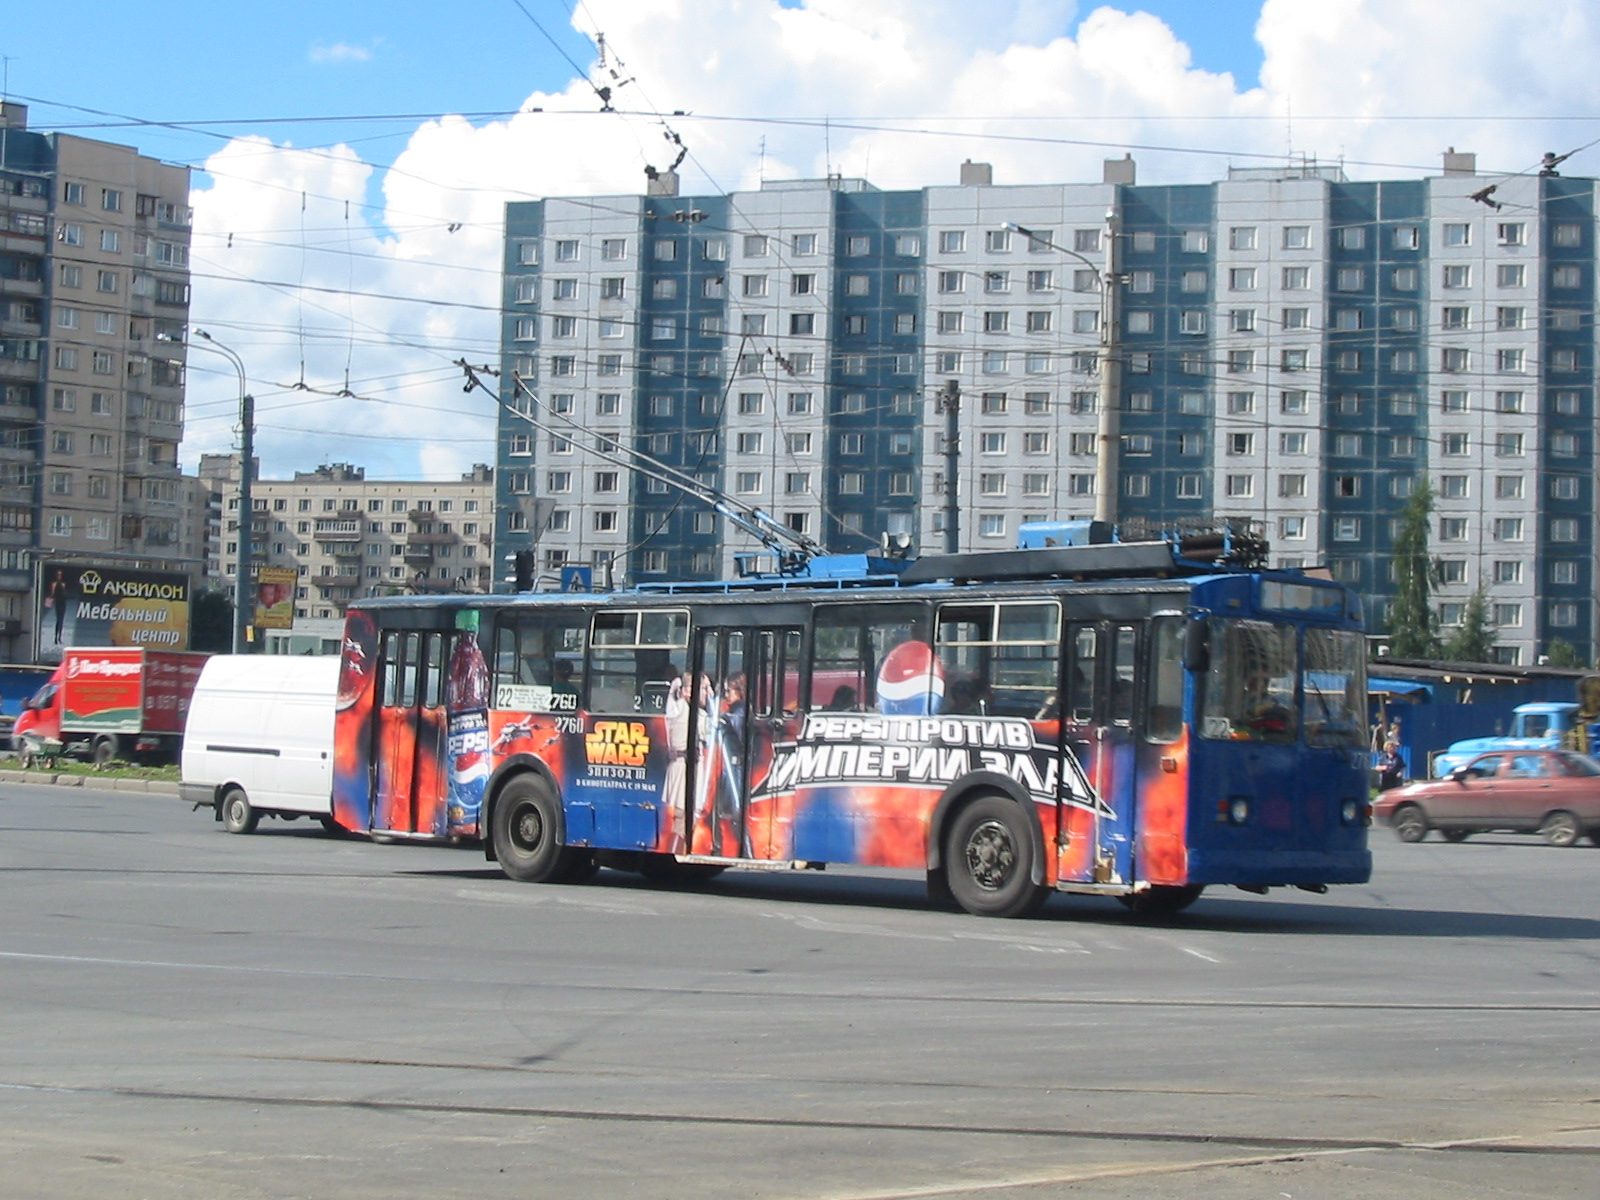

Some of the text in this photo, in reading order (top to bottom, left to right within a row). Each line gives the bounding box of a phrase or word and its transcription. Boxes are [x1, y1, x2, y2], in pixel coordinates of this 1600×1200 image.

[103, 581, 184, 599] АКВИЛОН
[76, 601, 167, 623] Мебельный
[131, 628, 180, 645] центр
[498, 687, 513, 707] 22
[544, 693, 577, 710] 2760
[554, 716, 584, 734] 2760
[585, 721, 650, 745] STAR
[806, 716, 1031, 749] PEPSI ПРОТИВ
[585, 741, 650, 766] WARS
[587, 765, 632, 780] ЭПИЗОД
[767, 745, 974, 790] ИМПЕРИИ
